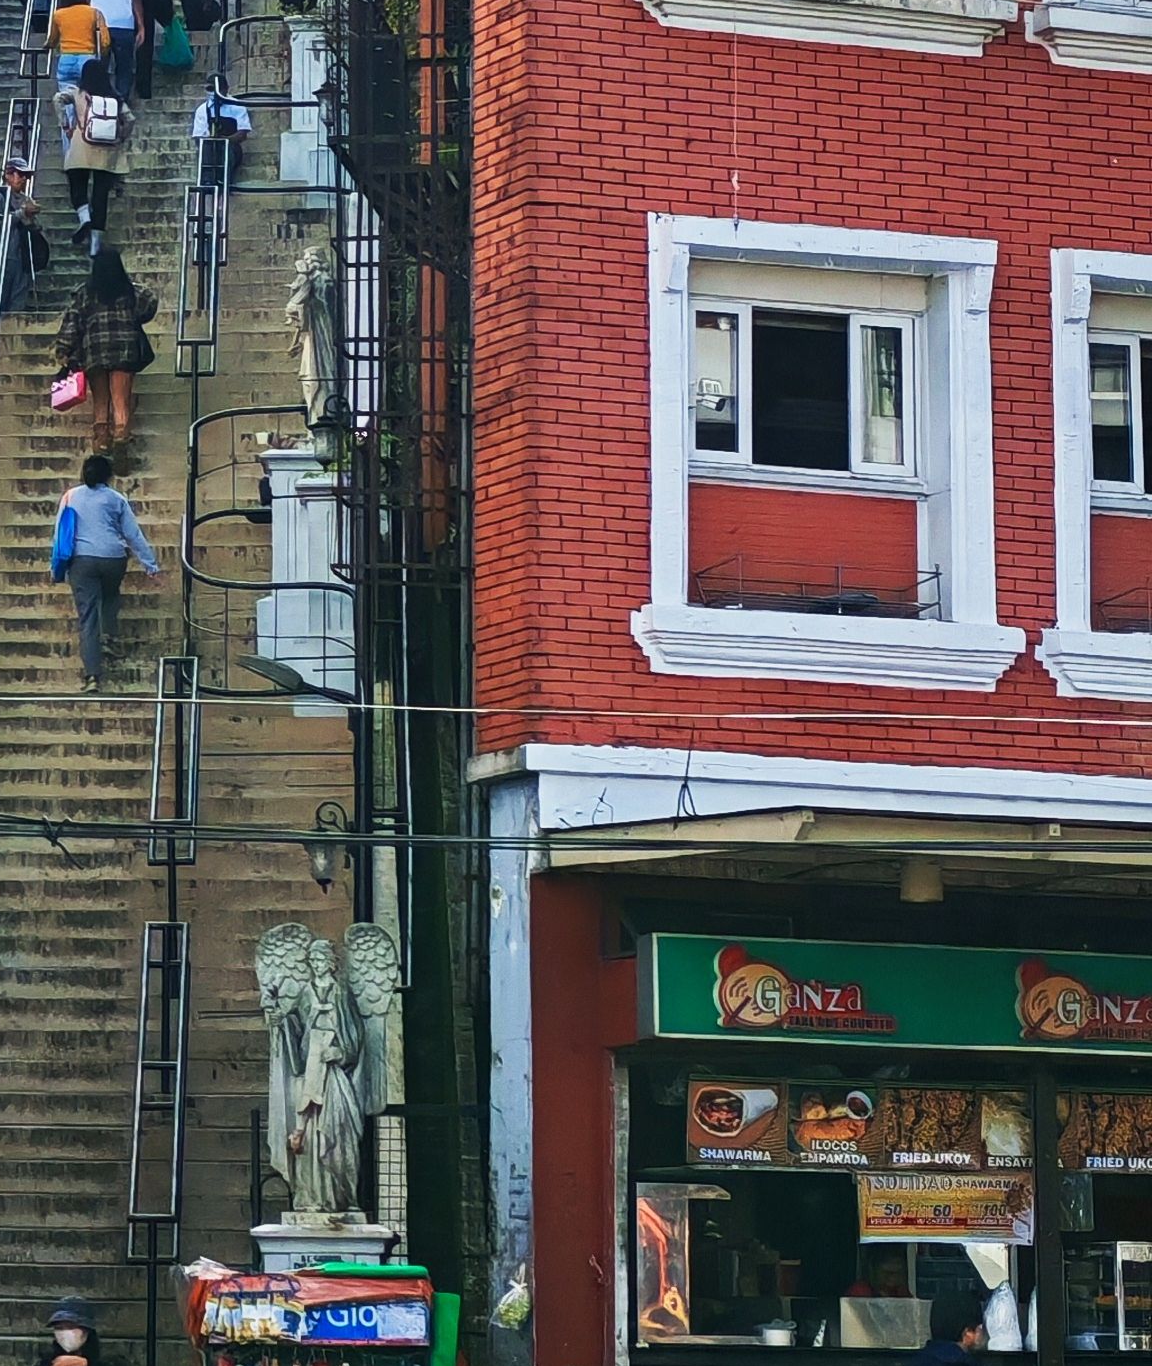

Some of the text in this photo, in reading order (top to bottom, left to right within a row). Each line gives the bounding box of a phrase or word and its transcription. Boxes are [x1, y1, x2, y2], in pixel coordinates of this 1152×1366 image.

[811, 1139, 858, 1152] ILOCOS
[699, 1147, 772, 1162] SHAWARMA
[800, 1152, 869, 1165] EMPANADA
[892, 1152, 972, 1165] FRIED UKOY
[1086, 1156, 1125, 1168] FRIED
[884, 1203, 903, 1217] 50
[933, 1204, 952, 1217] 60
